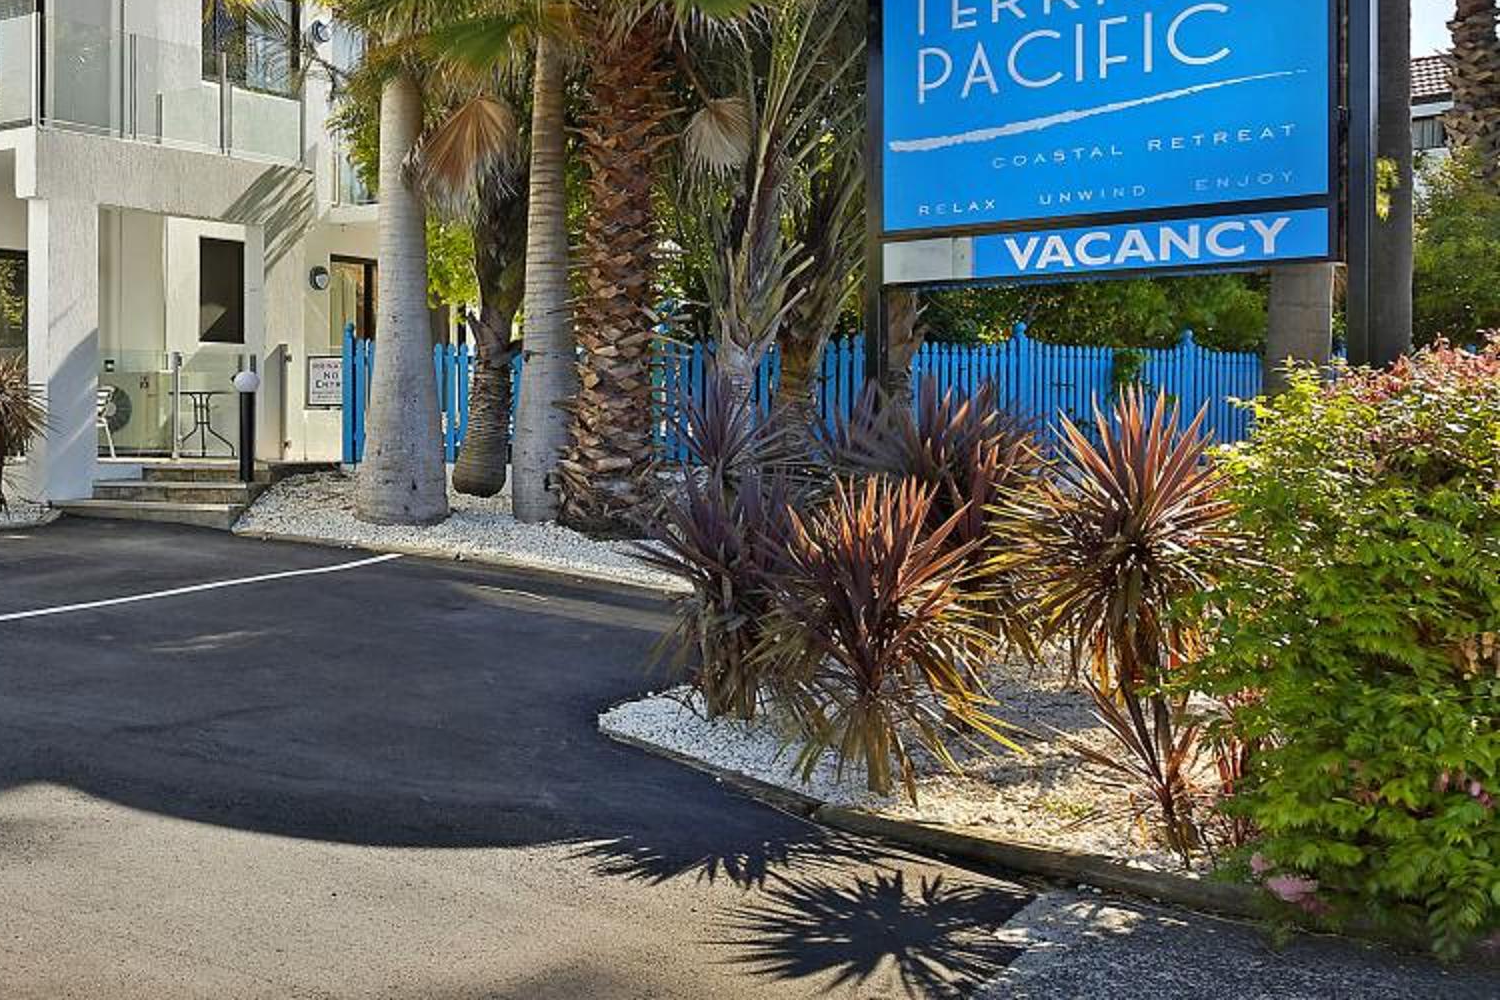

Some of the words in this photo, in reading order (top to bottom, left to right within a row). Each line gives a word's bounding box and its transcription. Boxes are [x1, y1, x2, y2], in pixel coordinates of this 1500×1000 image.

[917, 2, 1231, 105] PACIFIC
[991, 144, 1124, 169] COASTAL
[1147, 122, 1297, 152] RETREAT
[918, 198, 997, 217] RELAX
[1039, 184, 1147, 206] UNWIND
[1194, 170, 1295, 191] ENJOY
[1003, 216, 1291, 271] VACANCY
